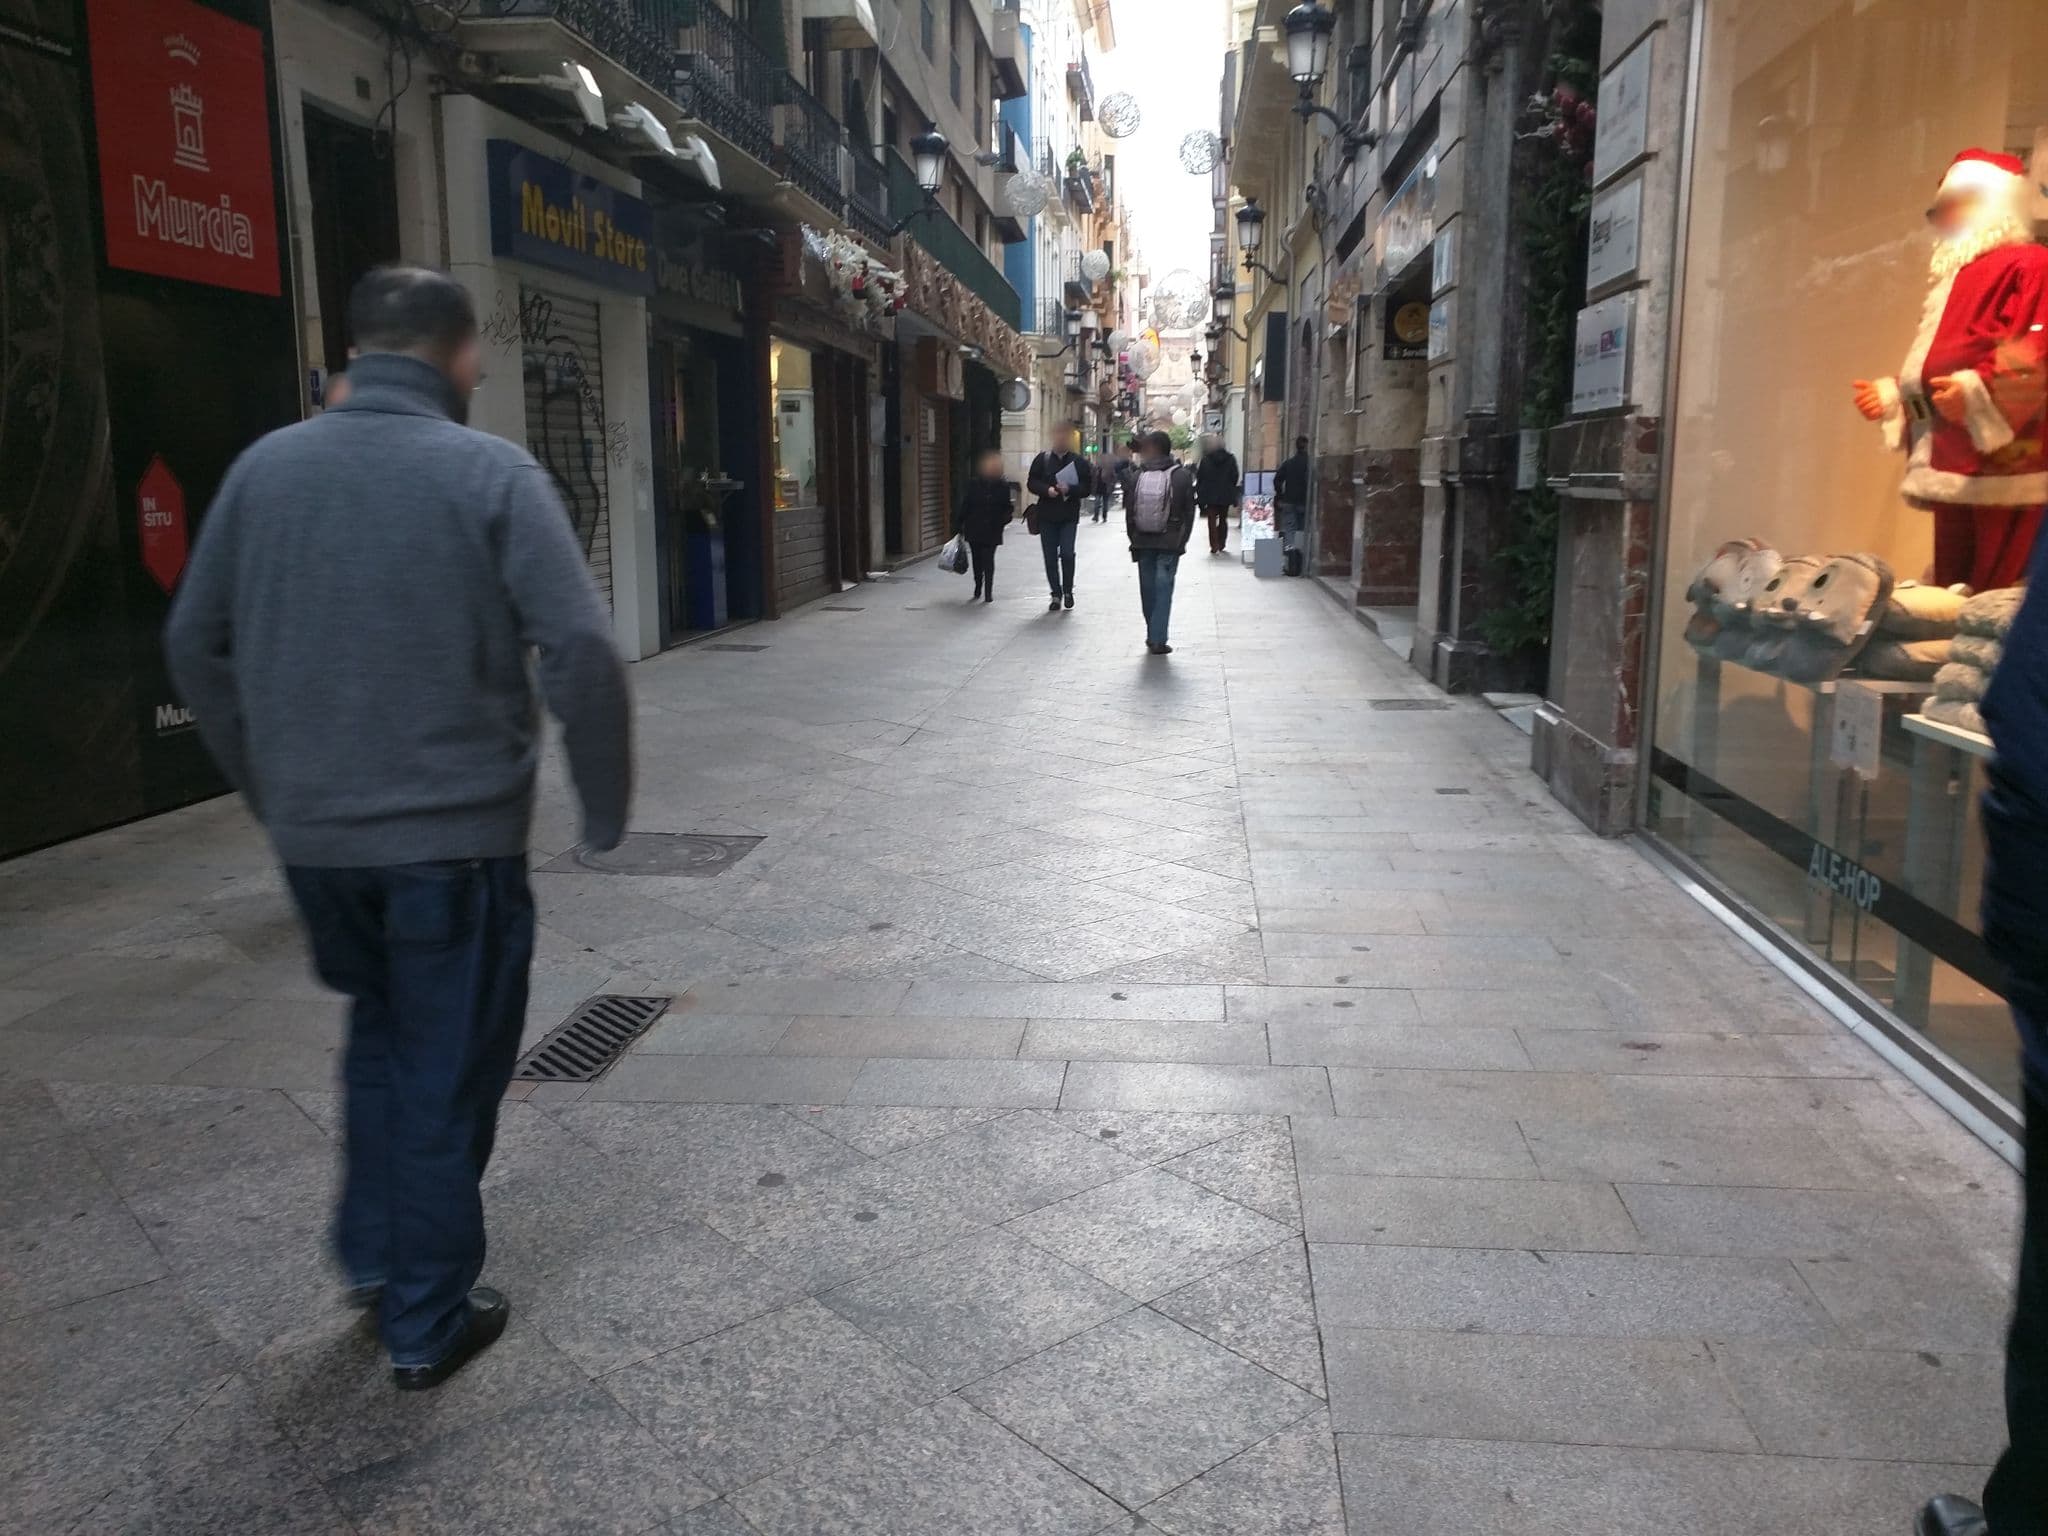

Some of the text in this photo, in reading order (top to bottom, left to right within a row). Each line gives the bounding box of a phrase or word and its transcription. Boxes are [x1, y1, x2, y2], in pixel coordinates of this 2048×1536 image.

[133, 174, 254, 260] Murcia
[594, 210, 646, 272] Store
[142, 497, 157, 512] IN
[144, 512, 173, 527] SITU
[1808, 843, 1881, 912] ALE-HOP
